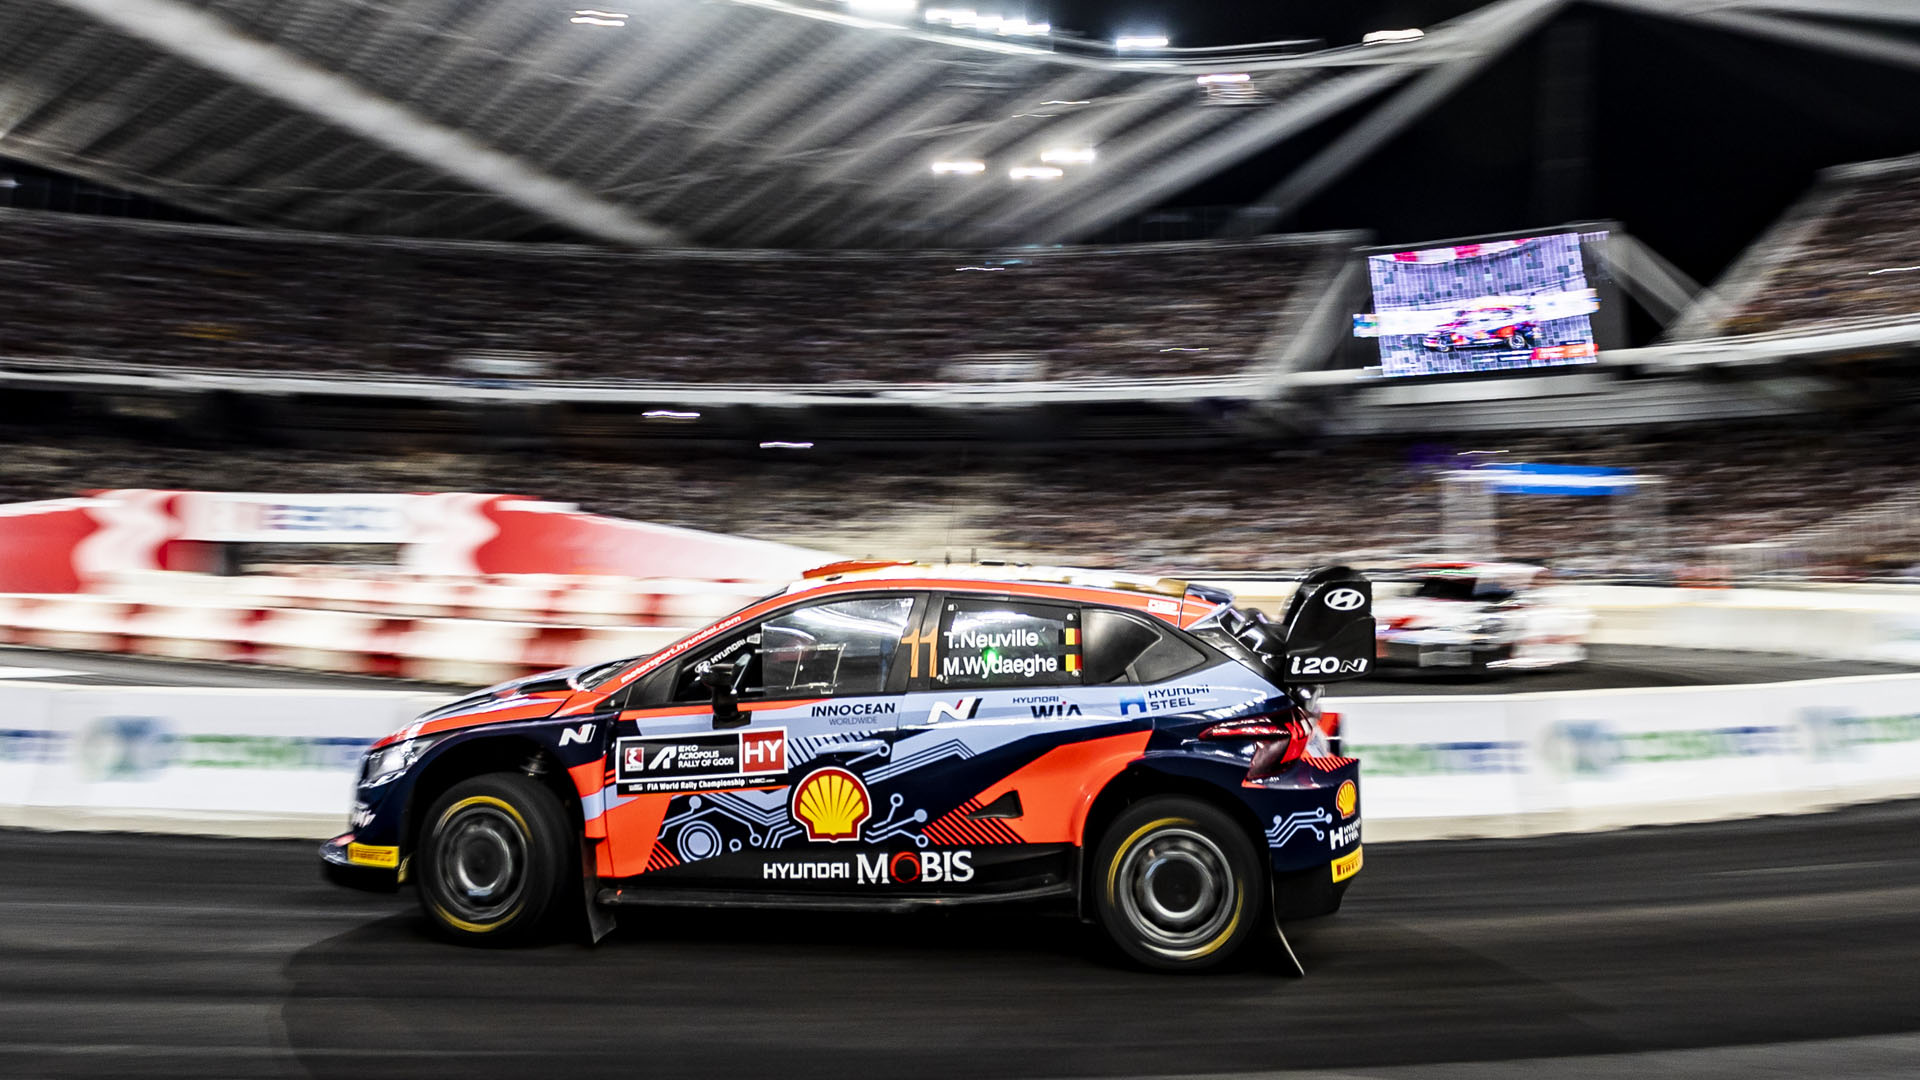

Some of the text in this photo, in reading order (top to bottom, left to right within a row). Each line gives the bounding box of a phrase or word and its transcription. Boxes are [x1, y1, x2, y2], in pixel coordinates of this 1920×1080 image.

[943, 629, 1039, 649] T.Neuville
[620, 615, 741, 684] motorsport.hyundai.com
[901, 627, 938, 679] 11
[943, 653, 1058, 679] M.Wydaeghe
[1148, 684, 1210, 699] HYUNDAI
[1012, 696, 1060, 704] HYUNDAI
[1150, 697, 1196, 711] STEEL
[811, 703, 896, 717] INNOCEAN
[829, 716, 878, 725] WORLDWIDE
[678, 750, 719, 760] ACROPOLIS
[744, 739, 783, 765] HY
[678, 757, 735, 769] RALLY OF GODS
[647, 782, 658, 791] FIA
[660, 781, 679, 790] World
[681, 780, 697, 790] Rally
[699, 778, 746, 788] Championship
[763, 851, 975, 884] HYUNDAI MOBIS
